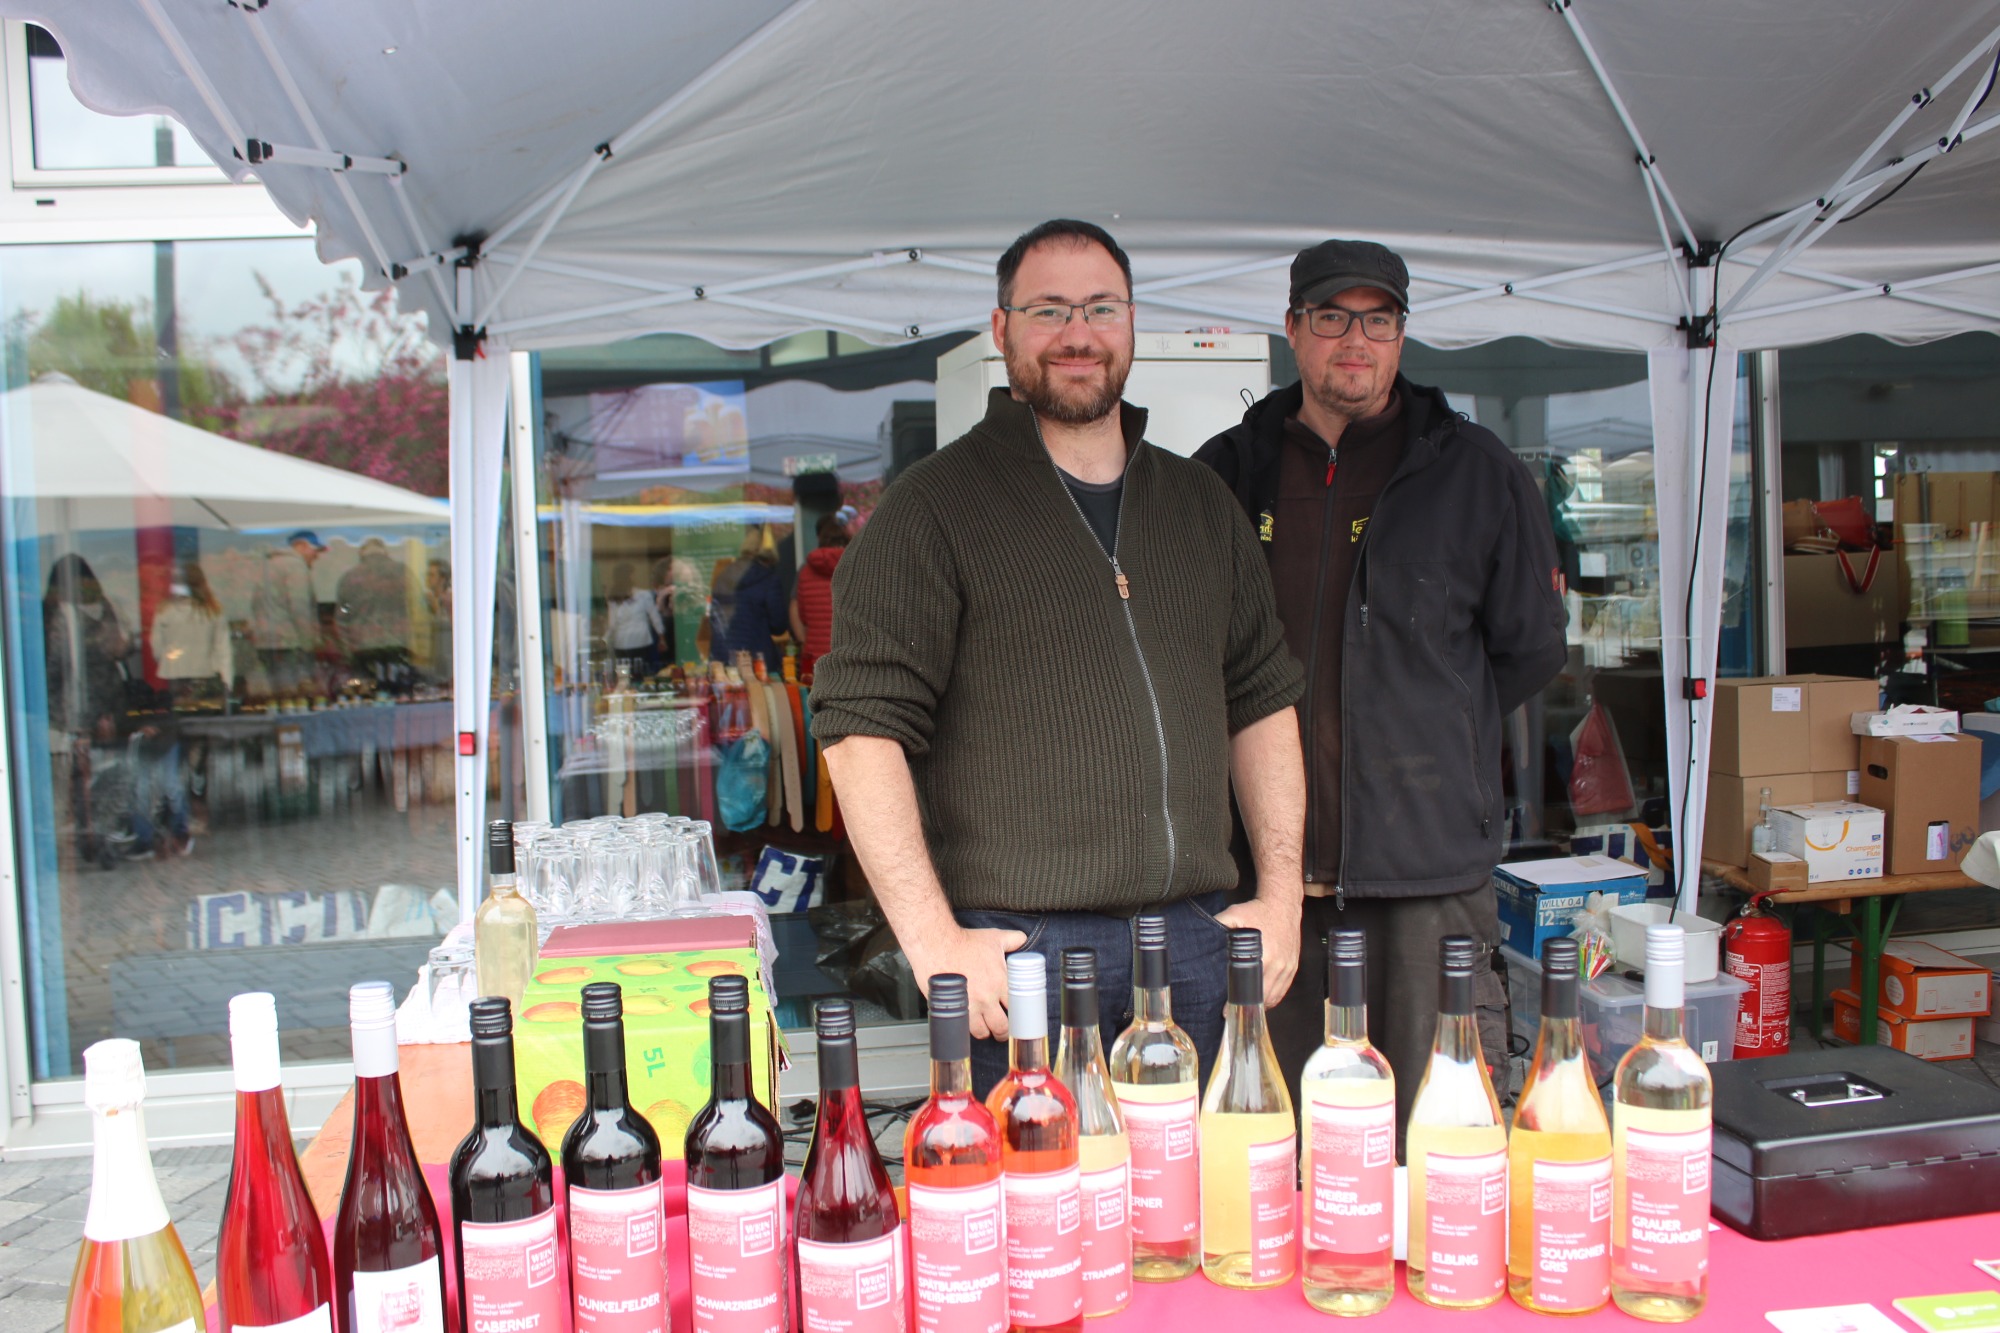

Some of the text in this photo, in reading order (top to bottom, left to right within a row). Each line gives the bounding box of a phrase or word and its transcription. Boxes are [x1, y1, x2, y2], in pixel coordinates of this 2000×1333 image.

[1845, 843, 1881, 855] Champagne
[1866, 851, 1881, 859] Flute
[1541, 897, 1582, 909] WILLY 0,4
[1538, 910, 1555, 927] 12
[643, 1047, 666, 1078] 5L
[1100, 1197, 1121, 1210] WEIN
[1131, 1197, 1163, 1209] ERNER
[1315, 1198, 1383, 1217] BURGUNDER
[632, 1220, 654, 1234] WEIN
[744, 1220, 771, 1234] WEIN
[1632, 1215, 1681, 1232] GRAUER
[1258, 1228, 1295, 1251] RIESLING
[1632, 1228, 1702, 1245] BURGUNDER
[531, 1247, 552, 1264] WEIN
[1431, 1251, 1479, 1266] ELBLING
[1539, 1243, 1605, 1261] SOUVIGNIER
[1082, 1262, 1126, 1281] ZTRAMINER
[1539, 1259, 1569, 1273] GRIS
[861, 1272, 886, 1287] WEIN
[1009, 1278, 1034, 1290] ROSÉ
[578, 1292, 660, 1313] DUNKELFELDER
[695, 1292, 777, 1311] SCHWARZRIESLING
[474, 1313, 540, 1333] CABERNET
